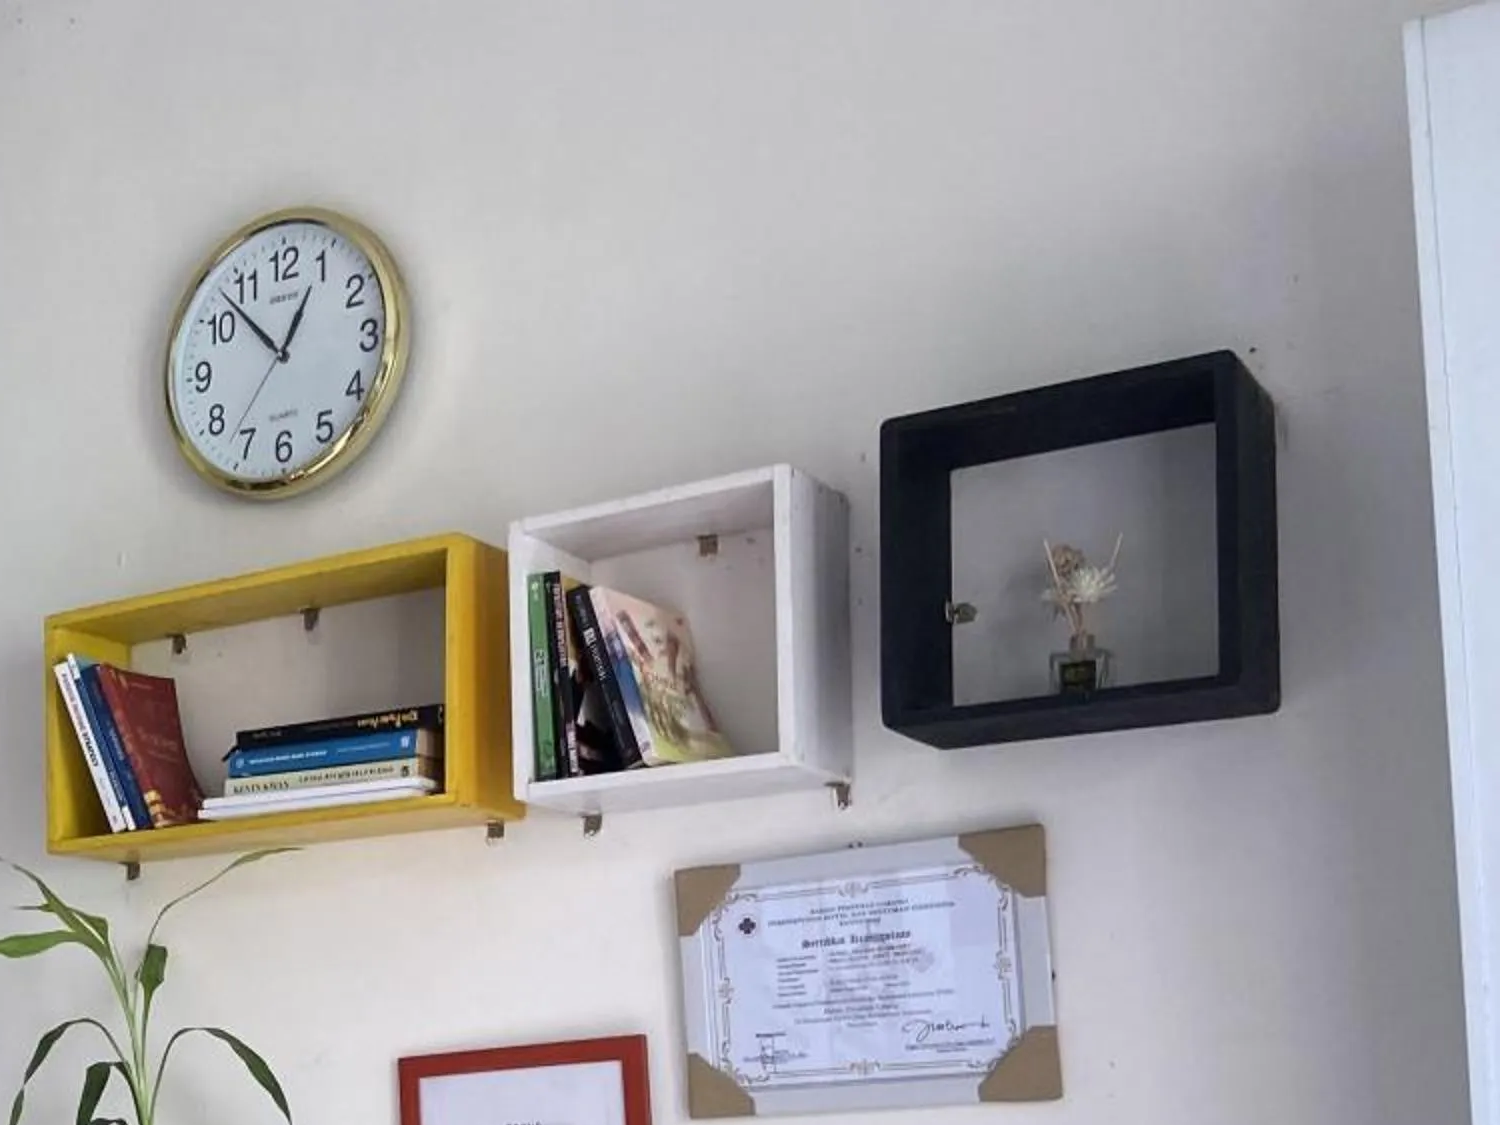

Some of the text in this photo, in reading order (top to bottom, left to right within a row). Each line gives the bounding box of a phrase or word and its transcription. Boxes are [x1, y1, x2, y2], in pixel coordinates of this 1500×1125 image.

[269, 245, 300, 282] 12
[315, 250, 327, 282] 1
[234, 269, 258, 304] 11
[345, 274, 365, 309] 2
[208, 311, 235, 345] 10
[360, 319, 379, 352] 3
[195, 361, 212, 393] 9
[345, 370, 365, 401] 4
[208, 403, 225, 436] 8
[316, 410, 334, 443] 5
[239, 427, 257, 460] 7
[275, 430, 293, 463] 6
